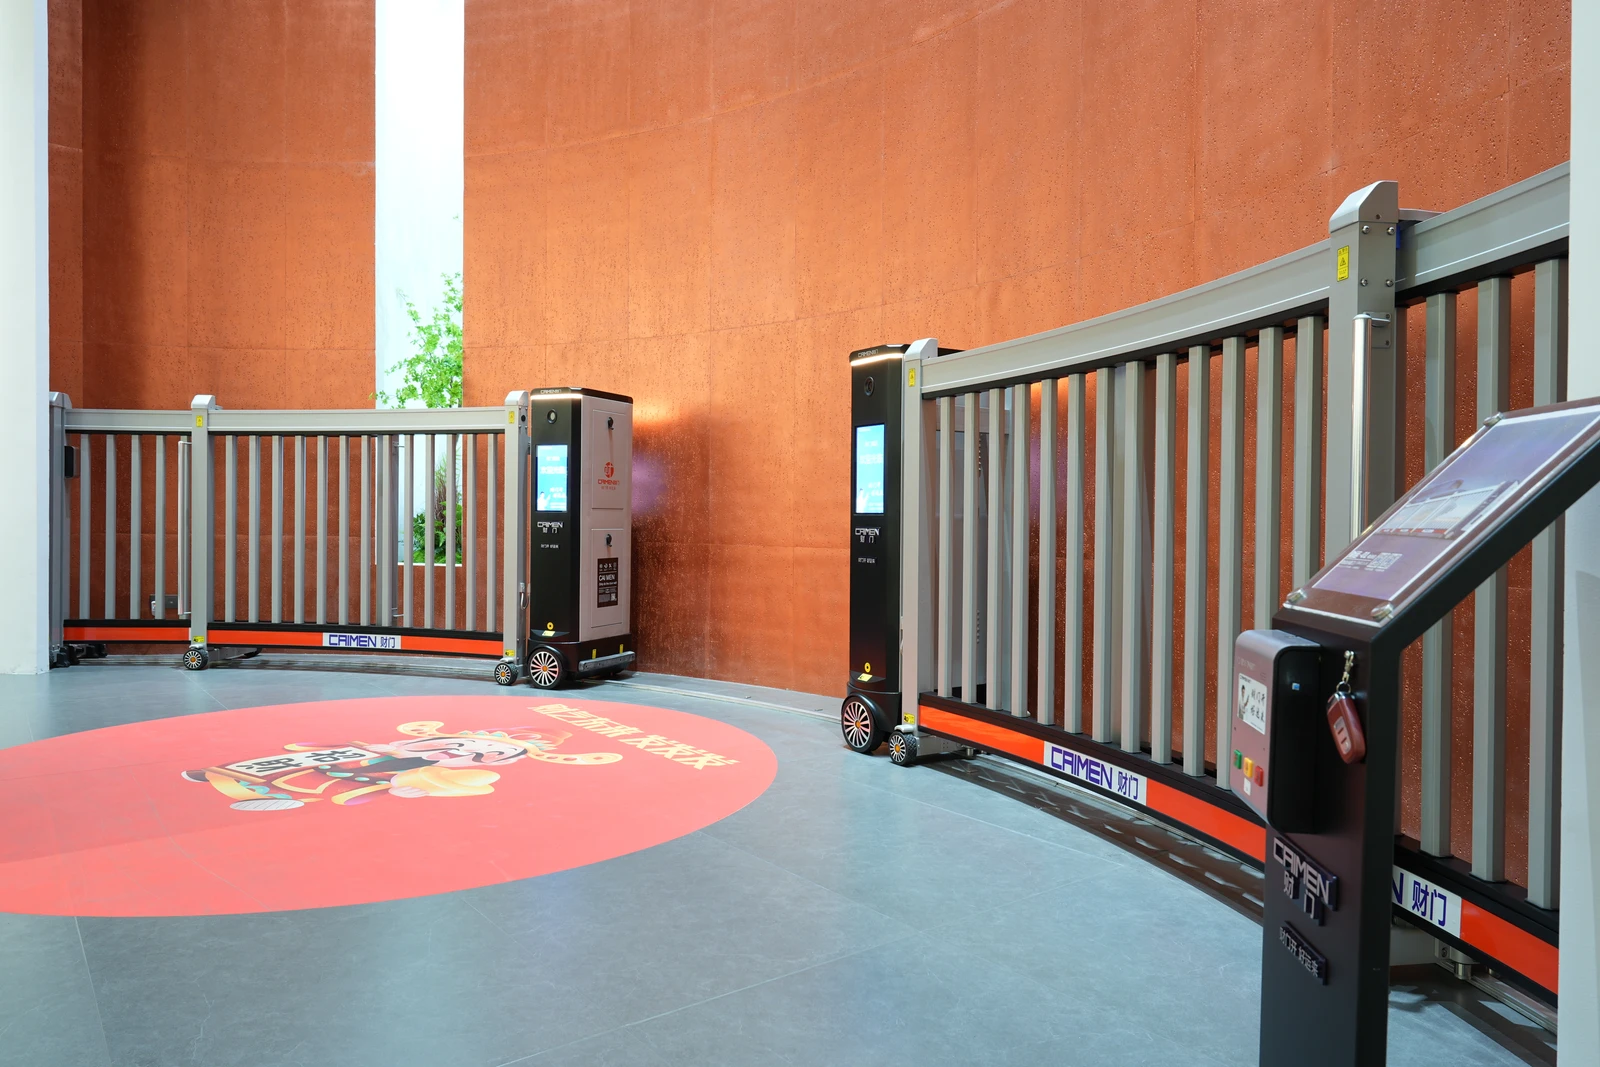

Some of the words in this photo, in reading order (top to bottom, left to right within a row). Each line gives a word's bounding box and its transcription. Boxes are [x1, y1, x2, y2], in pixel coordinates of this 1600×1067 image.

[328, 634, 377, 647] CAIMEN
[380, 636, 396, 648] 财门
[1051, 745, 1113, 790] CAIMEN
[1117, 770, 1139, 800] 财门
[1273, 836, 1330, 906] CAIMEN
[1411, 879, 1447, 927] 财门
